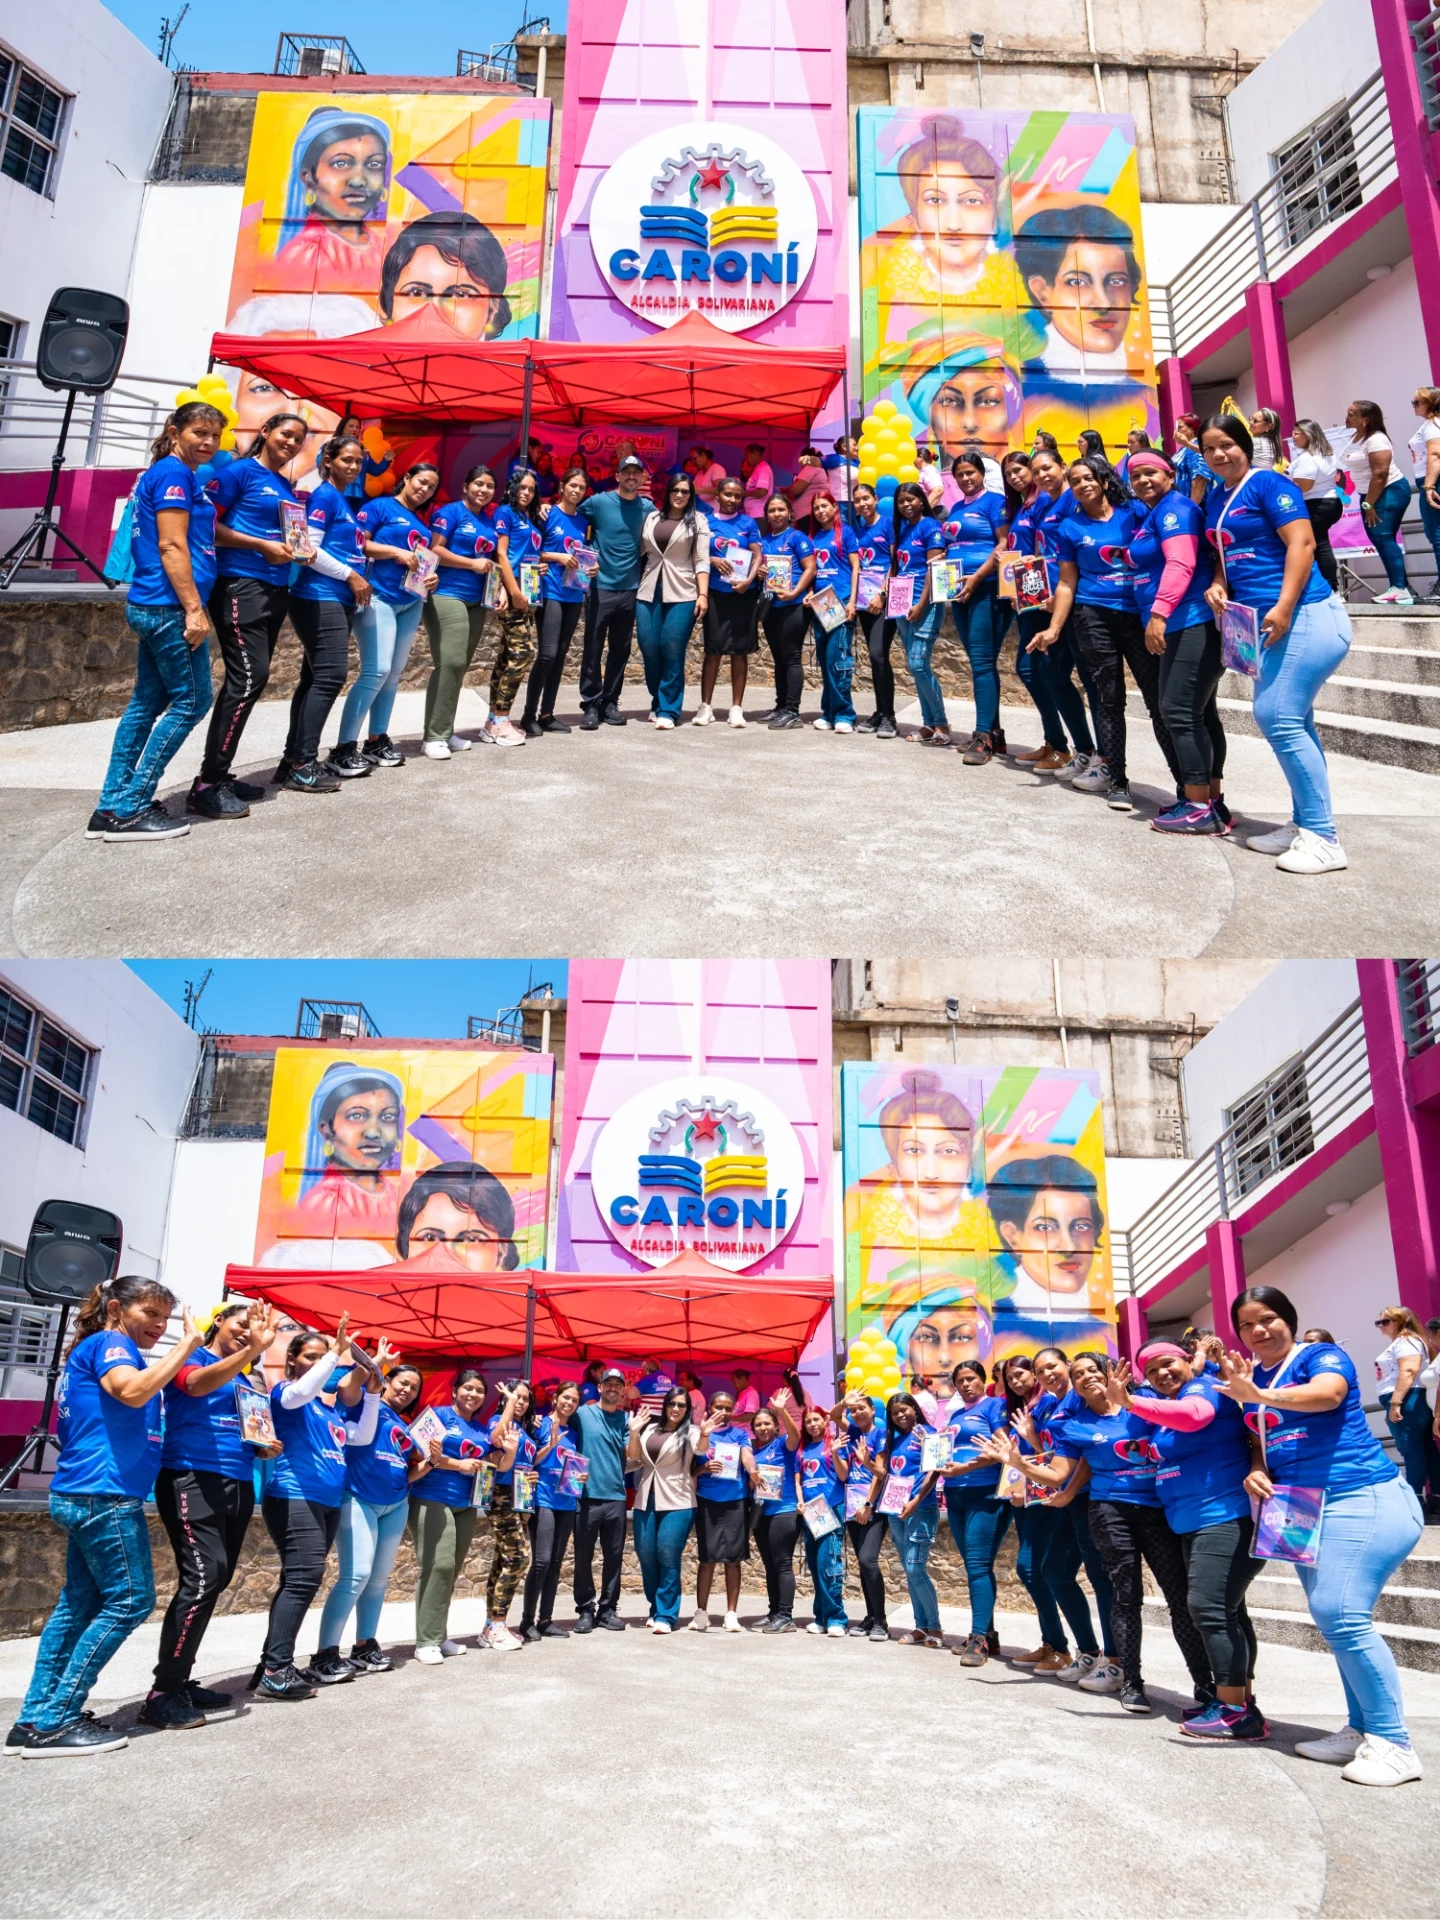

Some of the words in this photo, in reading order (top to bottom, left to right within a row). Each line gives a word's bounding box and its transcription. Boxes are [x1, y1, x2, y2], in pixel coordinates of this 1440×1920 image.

[609, 242, 800, 284] CARONÍ
[631, 295, 690, 309] ALCALDIA
[697, 296, 775, 311] BOLIVARIANA
[1022, 581, 1044, 594] SOCCER
[232, 598, 240, 619] NEW
[610, 1188, 788, 1229] CARONÍ
[631, 1239, 685, 1252] ALCALDIA
[693, 1240, 765, 1254] BOLIVARIANA
[180, 1492, 189, 1514] NEW
[193, 1549, 205, 1571] NEW
[195, 1572, 208, 1600] YORK
[173, 1628, 189, 1658] YORK
